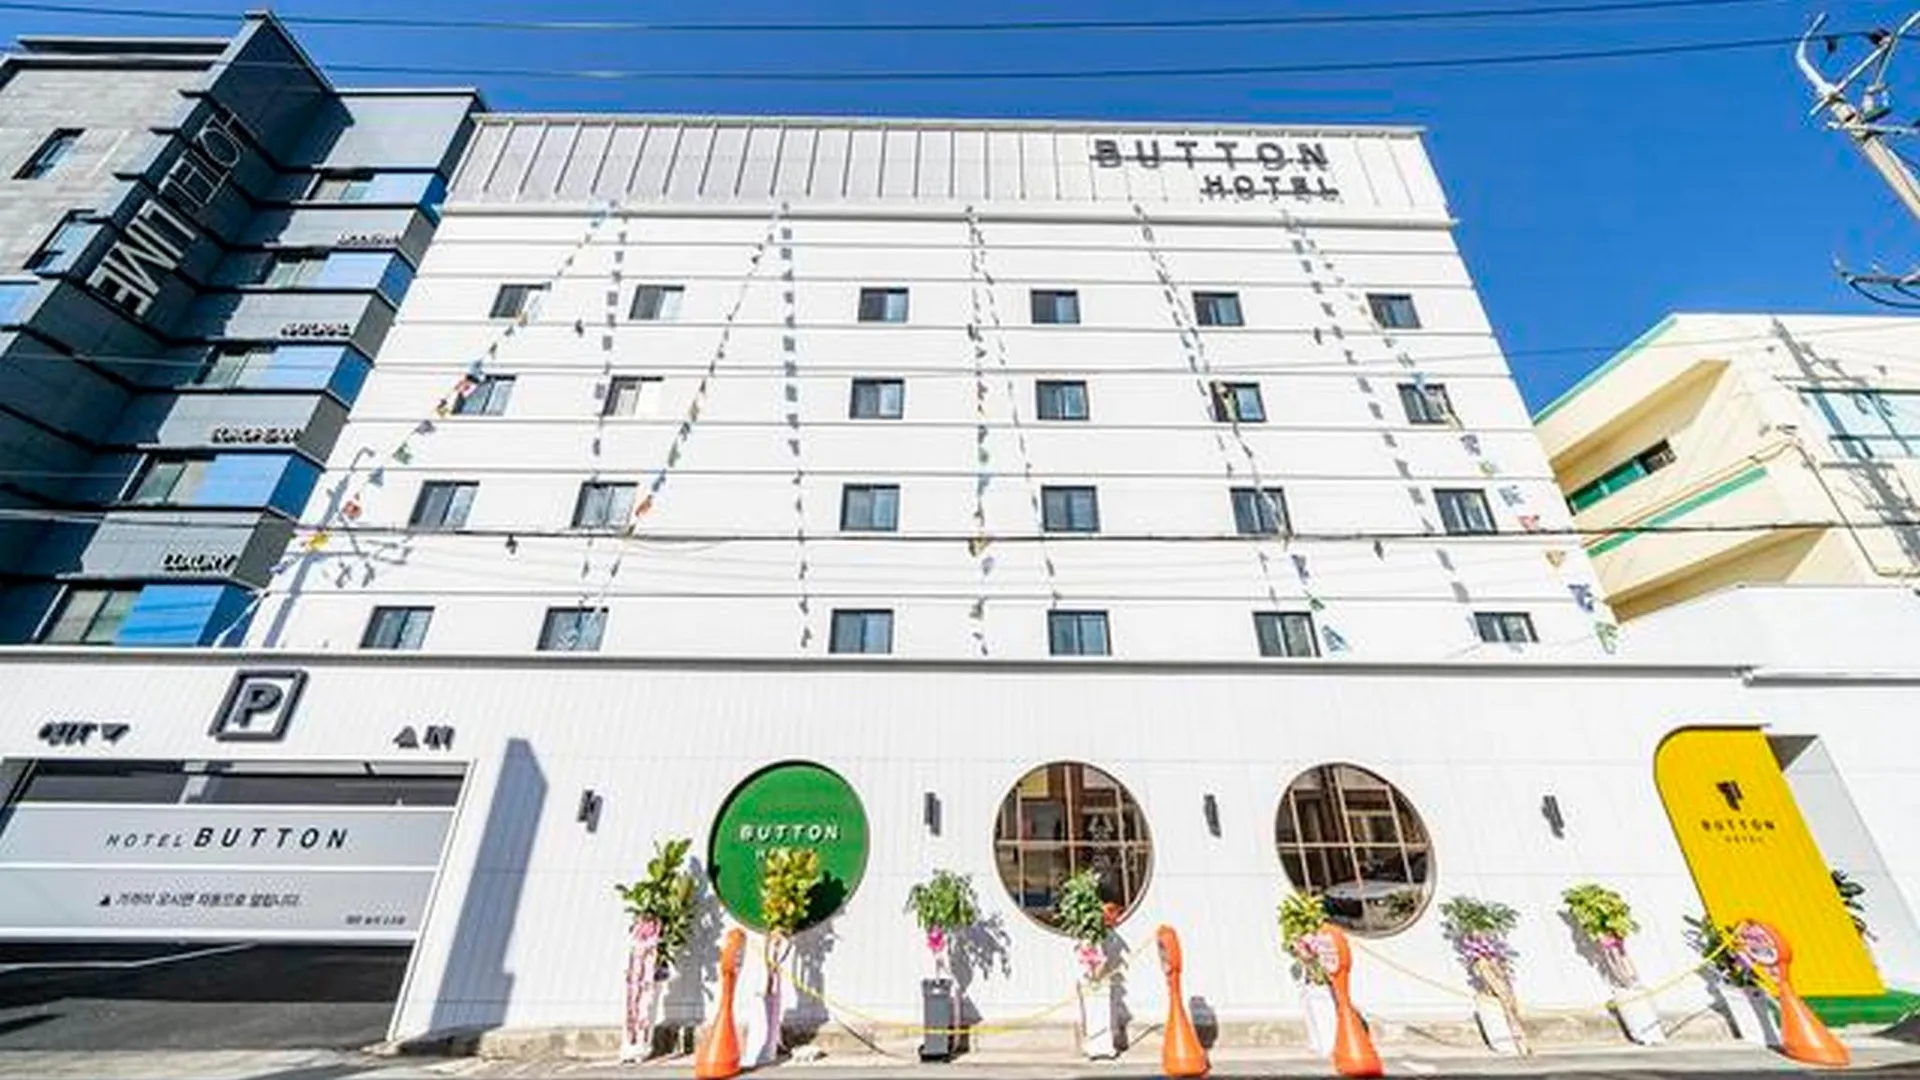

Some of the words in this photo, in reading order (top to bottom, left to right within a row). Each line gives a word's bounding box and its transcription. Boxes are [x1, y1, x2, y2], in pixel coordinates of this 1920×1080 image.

[1094, 138, 1329, 168] BUTTON
[1201, 174, 1339, 198] HOTEL
[237, 682, 283, 728] P
[106, 833, 187, 849] HOTEL
[193, 827, 350, 850] BUTTON
[740, 823, 839, 842] BUTTON
